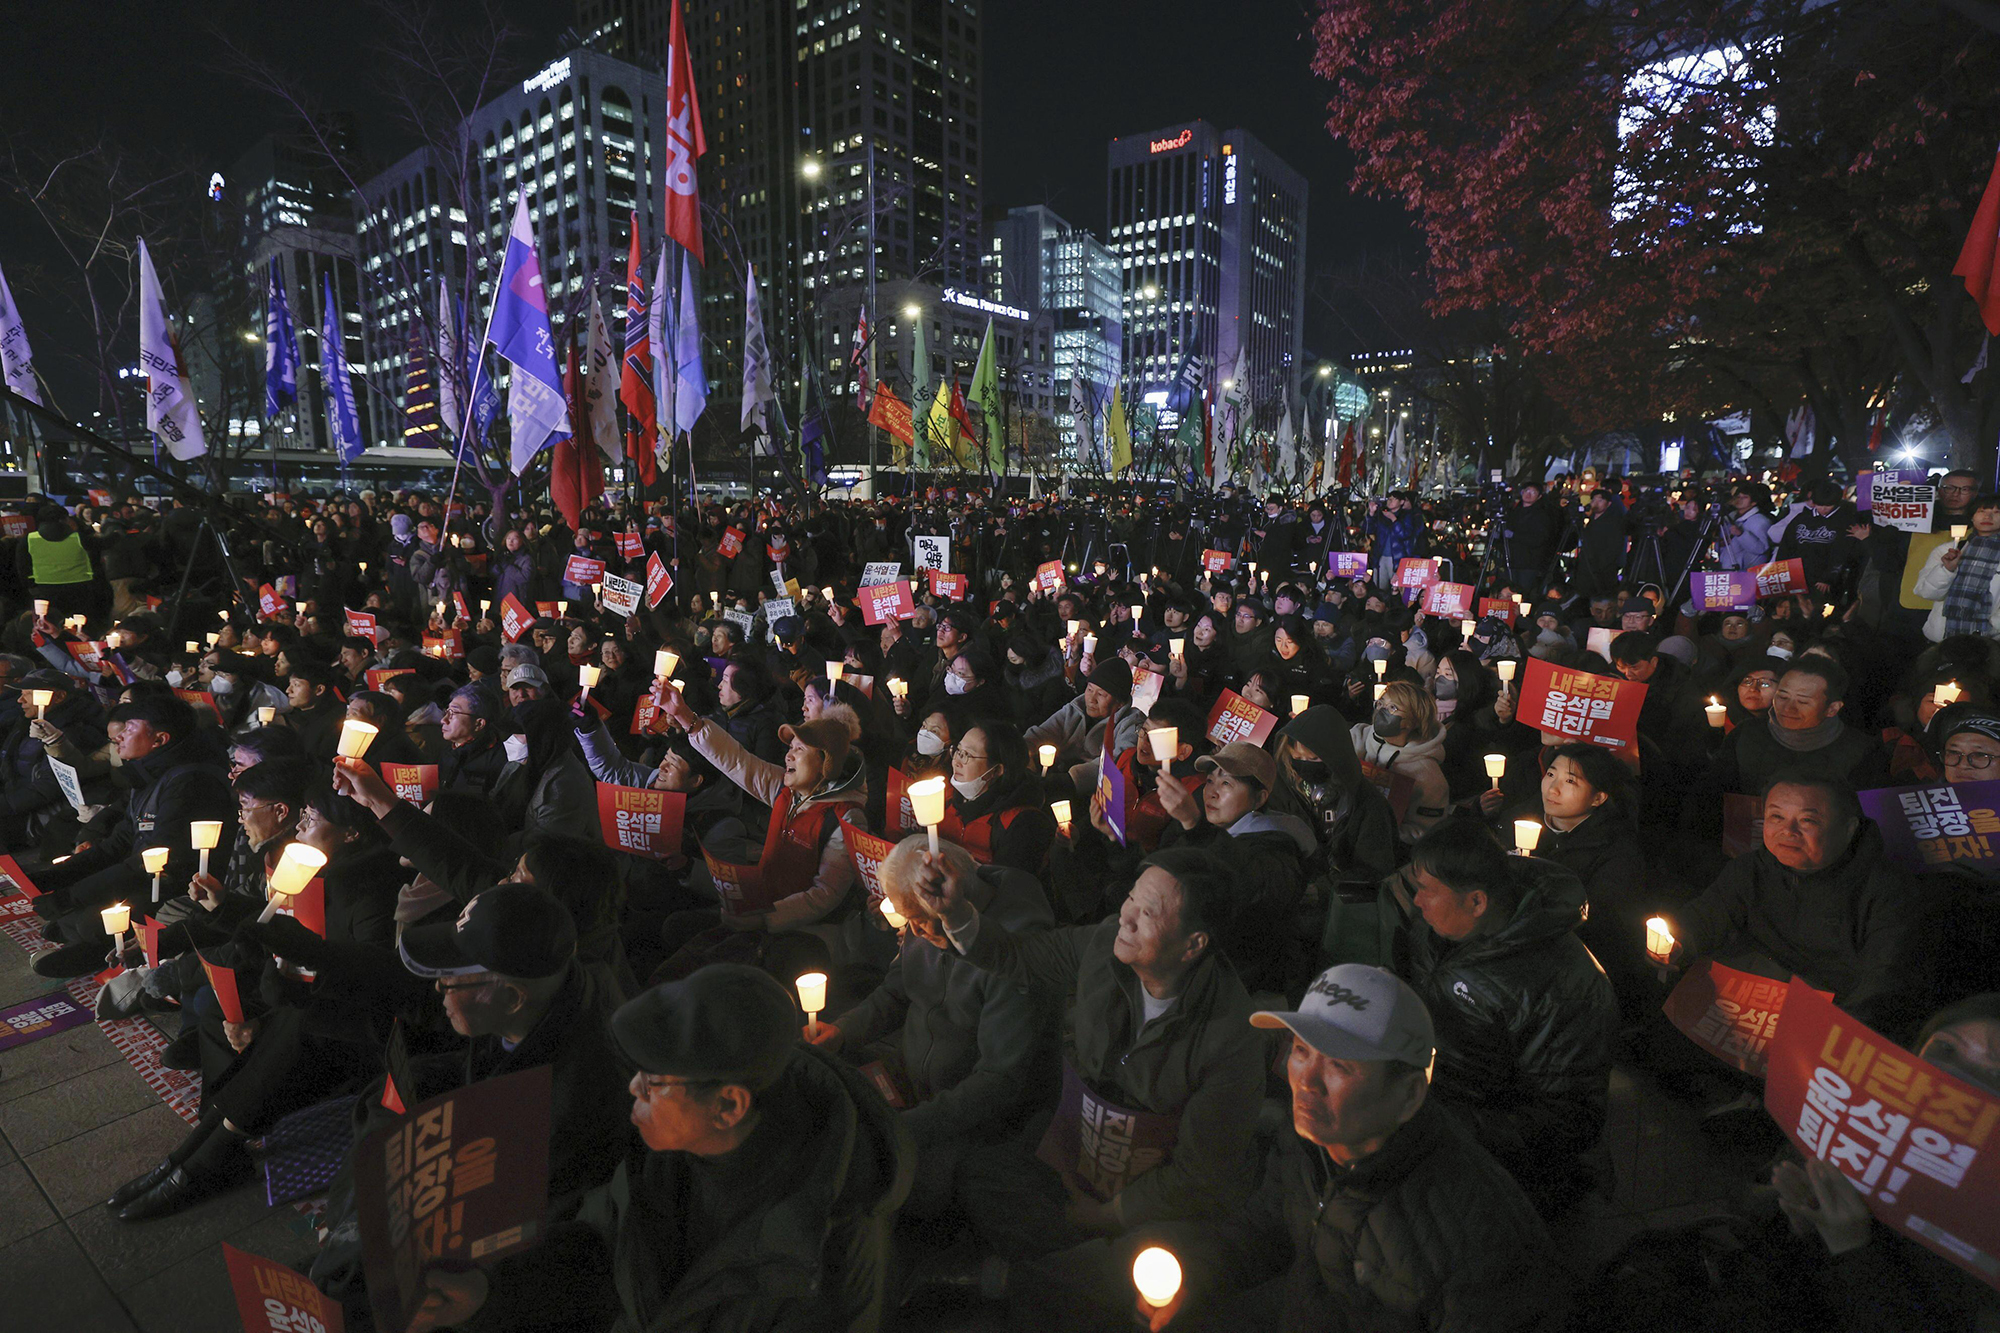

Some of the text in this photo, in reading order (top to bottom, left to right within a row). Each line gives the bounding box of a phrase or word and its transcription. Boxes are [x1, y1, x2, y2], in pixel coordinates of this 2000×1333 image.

[1150, 138, 1184, 153] kobaco
[1224, 154, 1237, 204] 서울신문
[1350, 352, 1370, 361] THE
[1873, 485, 1933, 503] 윤석열을
[1871, 502, 1929, 519] 탄핵하라
[1403, 567, 1428, 577] 윤석열
[1405, 560, 1429, 569] 내란죄
[1705, 574, 1730, 585] 퇴진
[1756, 571, 1792, 587] 윤석열
[870, 584, 899, 600] 내란죄
[1432, 594, 1460, 604] 윤석열
[1704, 584, 1742, 597] 광장을
[1758, 584, 1787, 596] 퇴진!
[872, 594, 901, 611] 윤석열
[1487, 601, 1510, 609] 내란죄
[1704, 597, 1733, 608] 열자!
[874, 607, 898, 621] 퇴진!
[1486, 609, 1509, 620] 윤석열
[1549, 671, 1620, 700] 내란죄
[1226, 697, 1263, 723] 내란죄
[1545, 690, 1614, 720] 윤석열
[1217, 710, 1255, 737] 윤석열
[1540, 709, 1594, 736] 퇴진!
[1210, 723, 1239, 745] 퇴진!
[393, 767, 421, 784] 내란죄
[395, 784, 423, 801] 윤석열
[615, 791, 664, 813] 내란죄
[1898, 787, 1962, 815] 퇴진
[616, 811, 662, 834] 윤석열
[1907, 808, 2000, 840] 광장을
[618, 830, 651, 851] 퇴진!
[851, 831, 888, 863] 내란죄
[1916, 835, 1995, 865] 열자!
[1460, 992, 1476, 1006] NEPA
[1820, 1024, 2000, 1147] 내란죄
[1081, 1093, 1136, 1145] 퇴진
[1806, 1066, 1977, 1189] 윤석열
[385, 1100, 454, 1191] 퇴진
[1795, 1102, 1911, 1204] 퇴진!
[387, 1137, 498, 1249] 광장을
[252, 1265, 323, 1322] 내란죄
